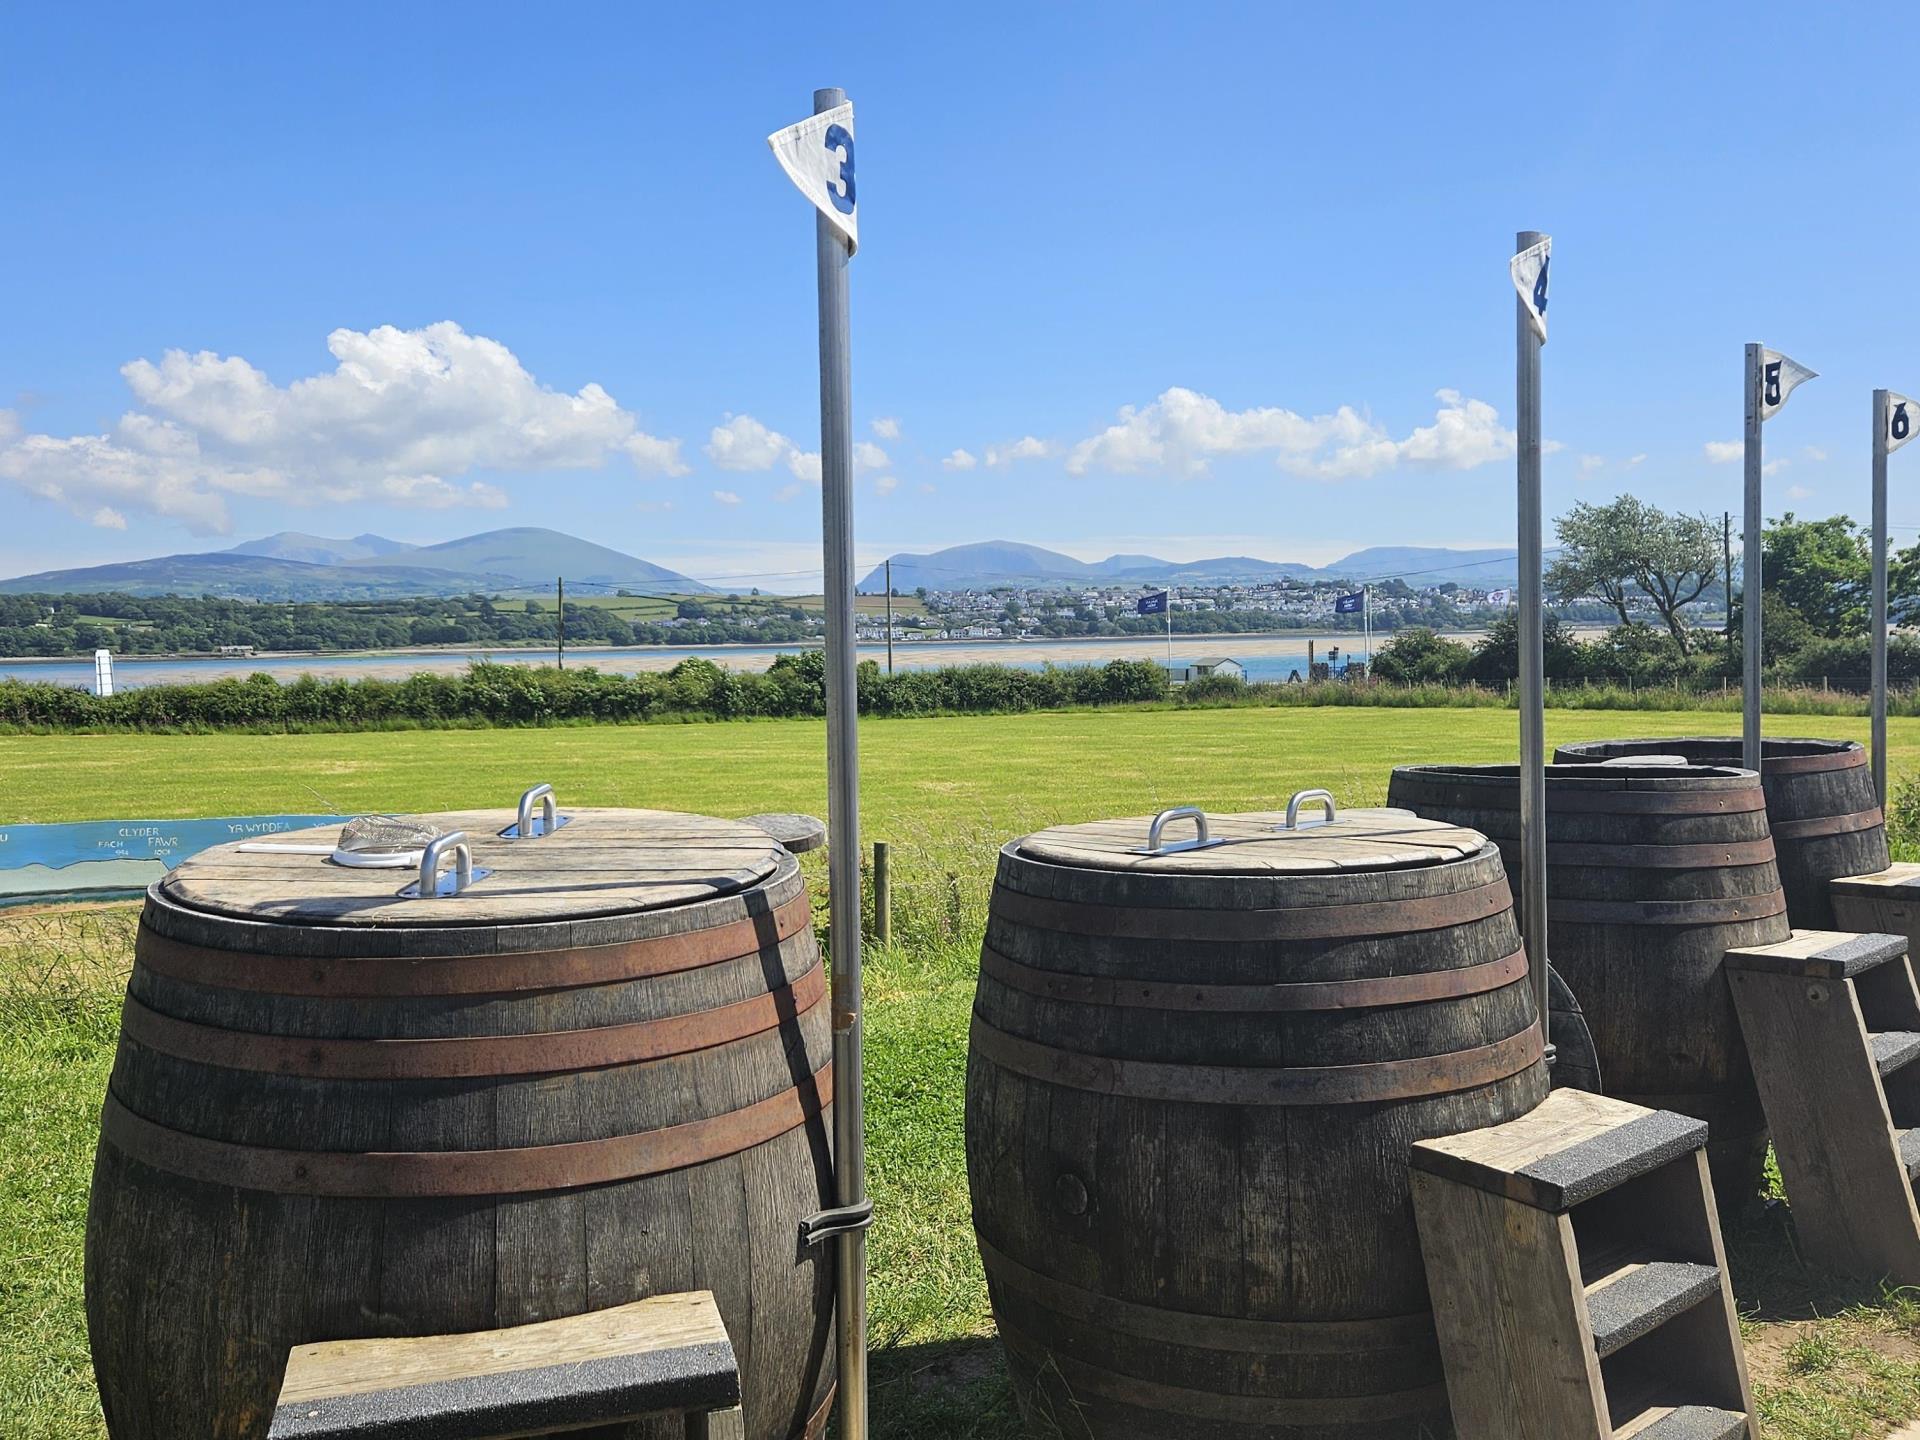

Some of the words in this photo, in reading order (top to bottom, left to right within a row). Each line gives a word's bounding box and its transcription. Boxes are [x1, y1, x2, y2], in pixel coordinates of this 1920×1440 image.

[824, 123, 856, 216] 3
[1533, 254, 1550, 317] 4
[1765, 360, 1782, 407] 5
[1891, 402, 1909, 440] 6
[98, 840, 124, 848] FACH
[147, 836, 178, 847] FAWR
[227, 824, 243, 833] YR
[245, 822, 291, 833] WYDDFA
